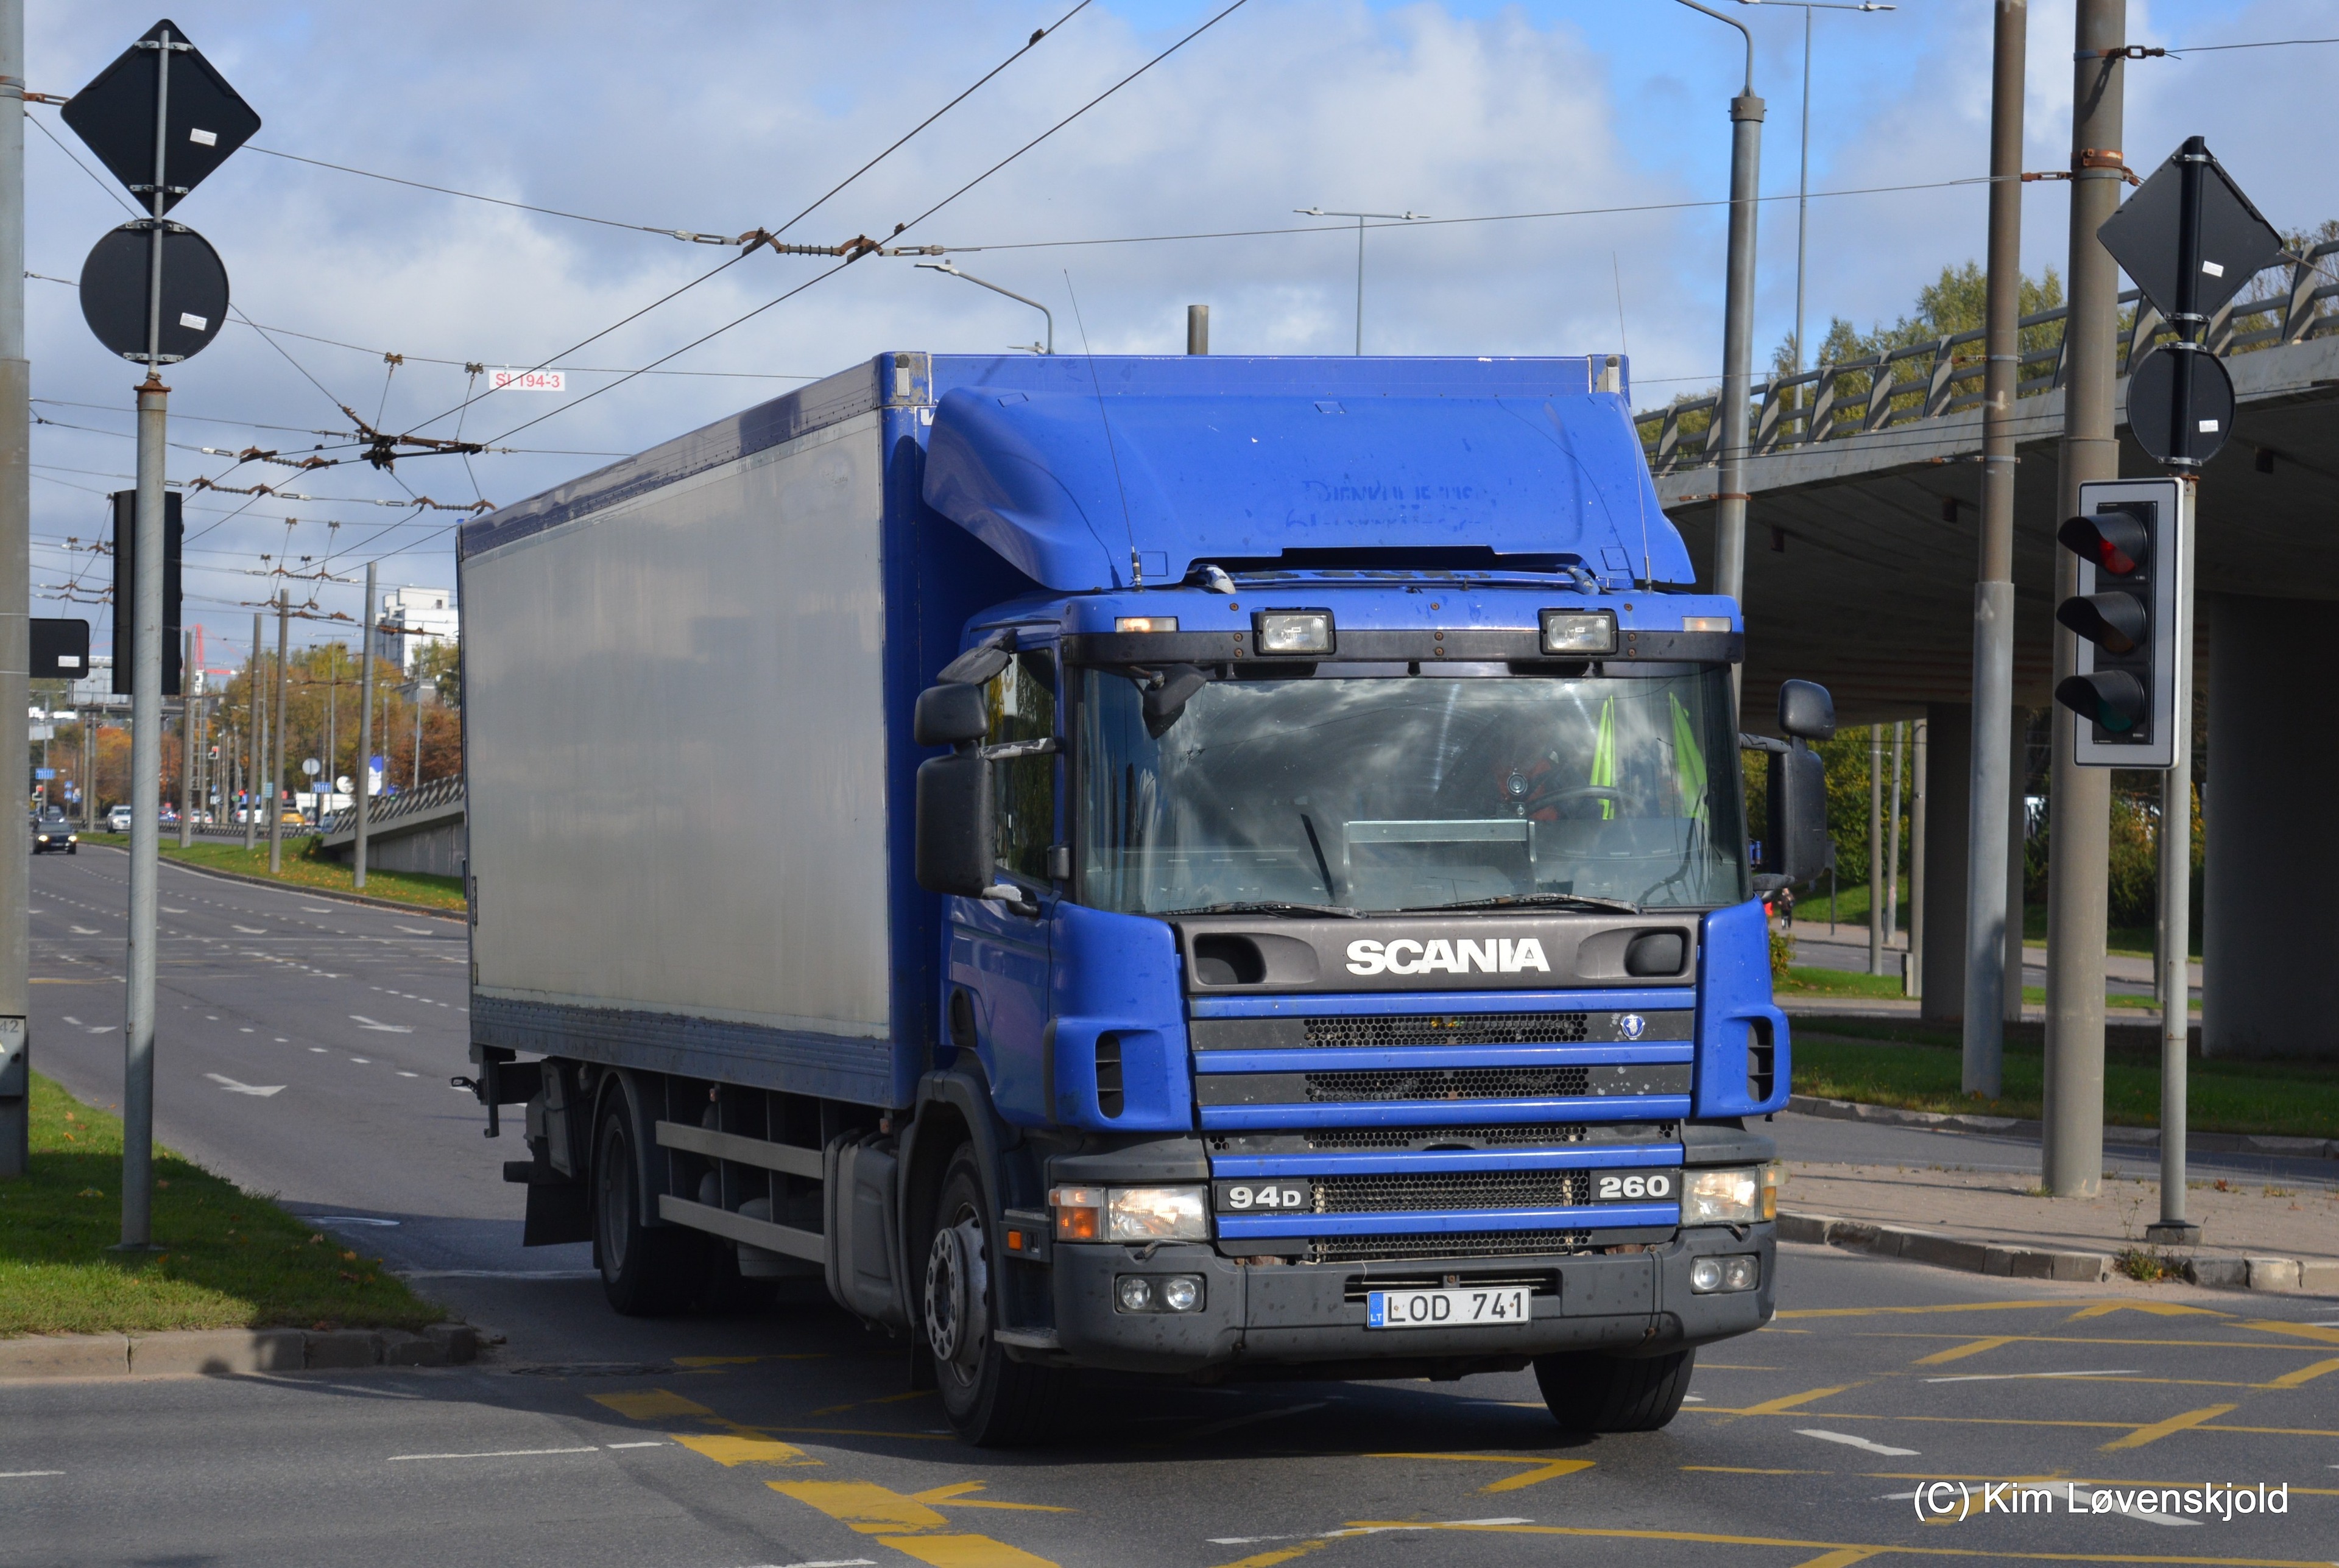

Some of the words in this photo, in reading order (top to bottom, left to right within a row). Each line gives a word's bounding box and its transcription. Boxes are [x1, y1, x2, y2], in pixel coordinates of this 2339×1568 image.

[495, 373, 511, 387] SI
[520, 374, 560, 388] 194-3
[1346, 938, 1551, 976] SCANIA
[1229, 1185, 1302, 1209] 94D
[1598, 1175, 1670, 1199] 260
[1370, 1313, 1383, 1322] LT
[1387, 1295, 1451, 1323] LOD
[1472, 1291, 1522, 1320] 741
